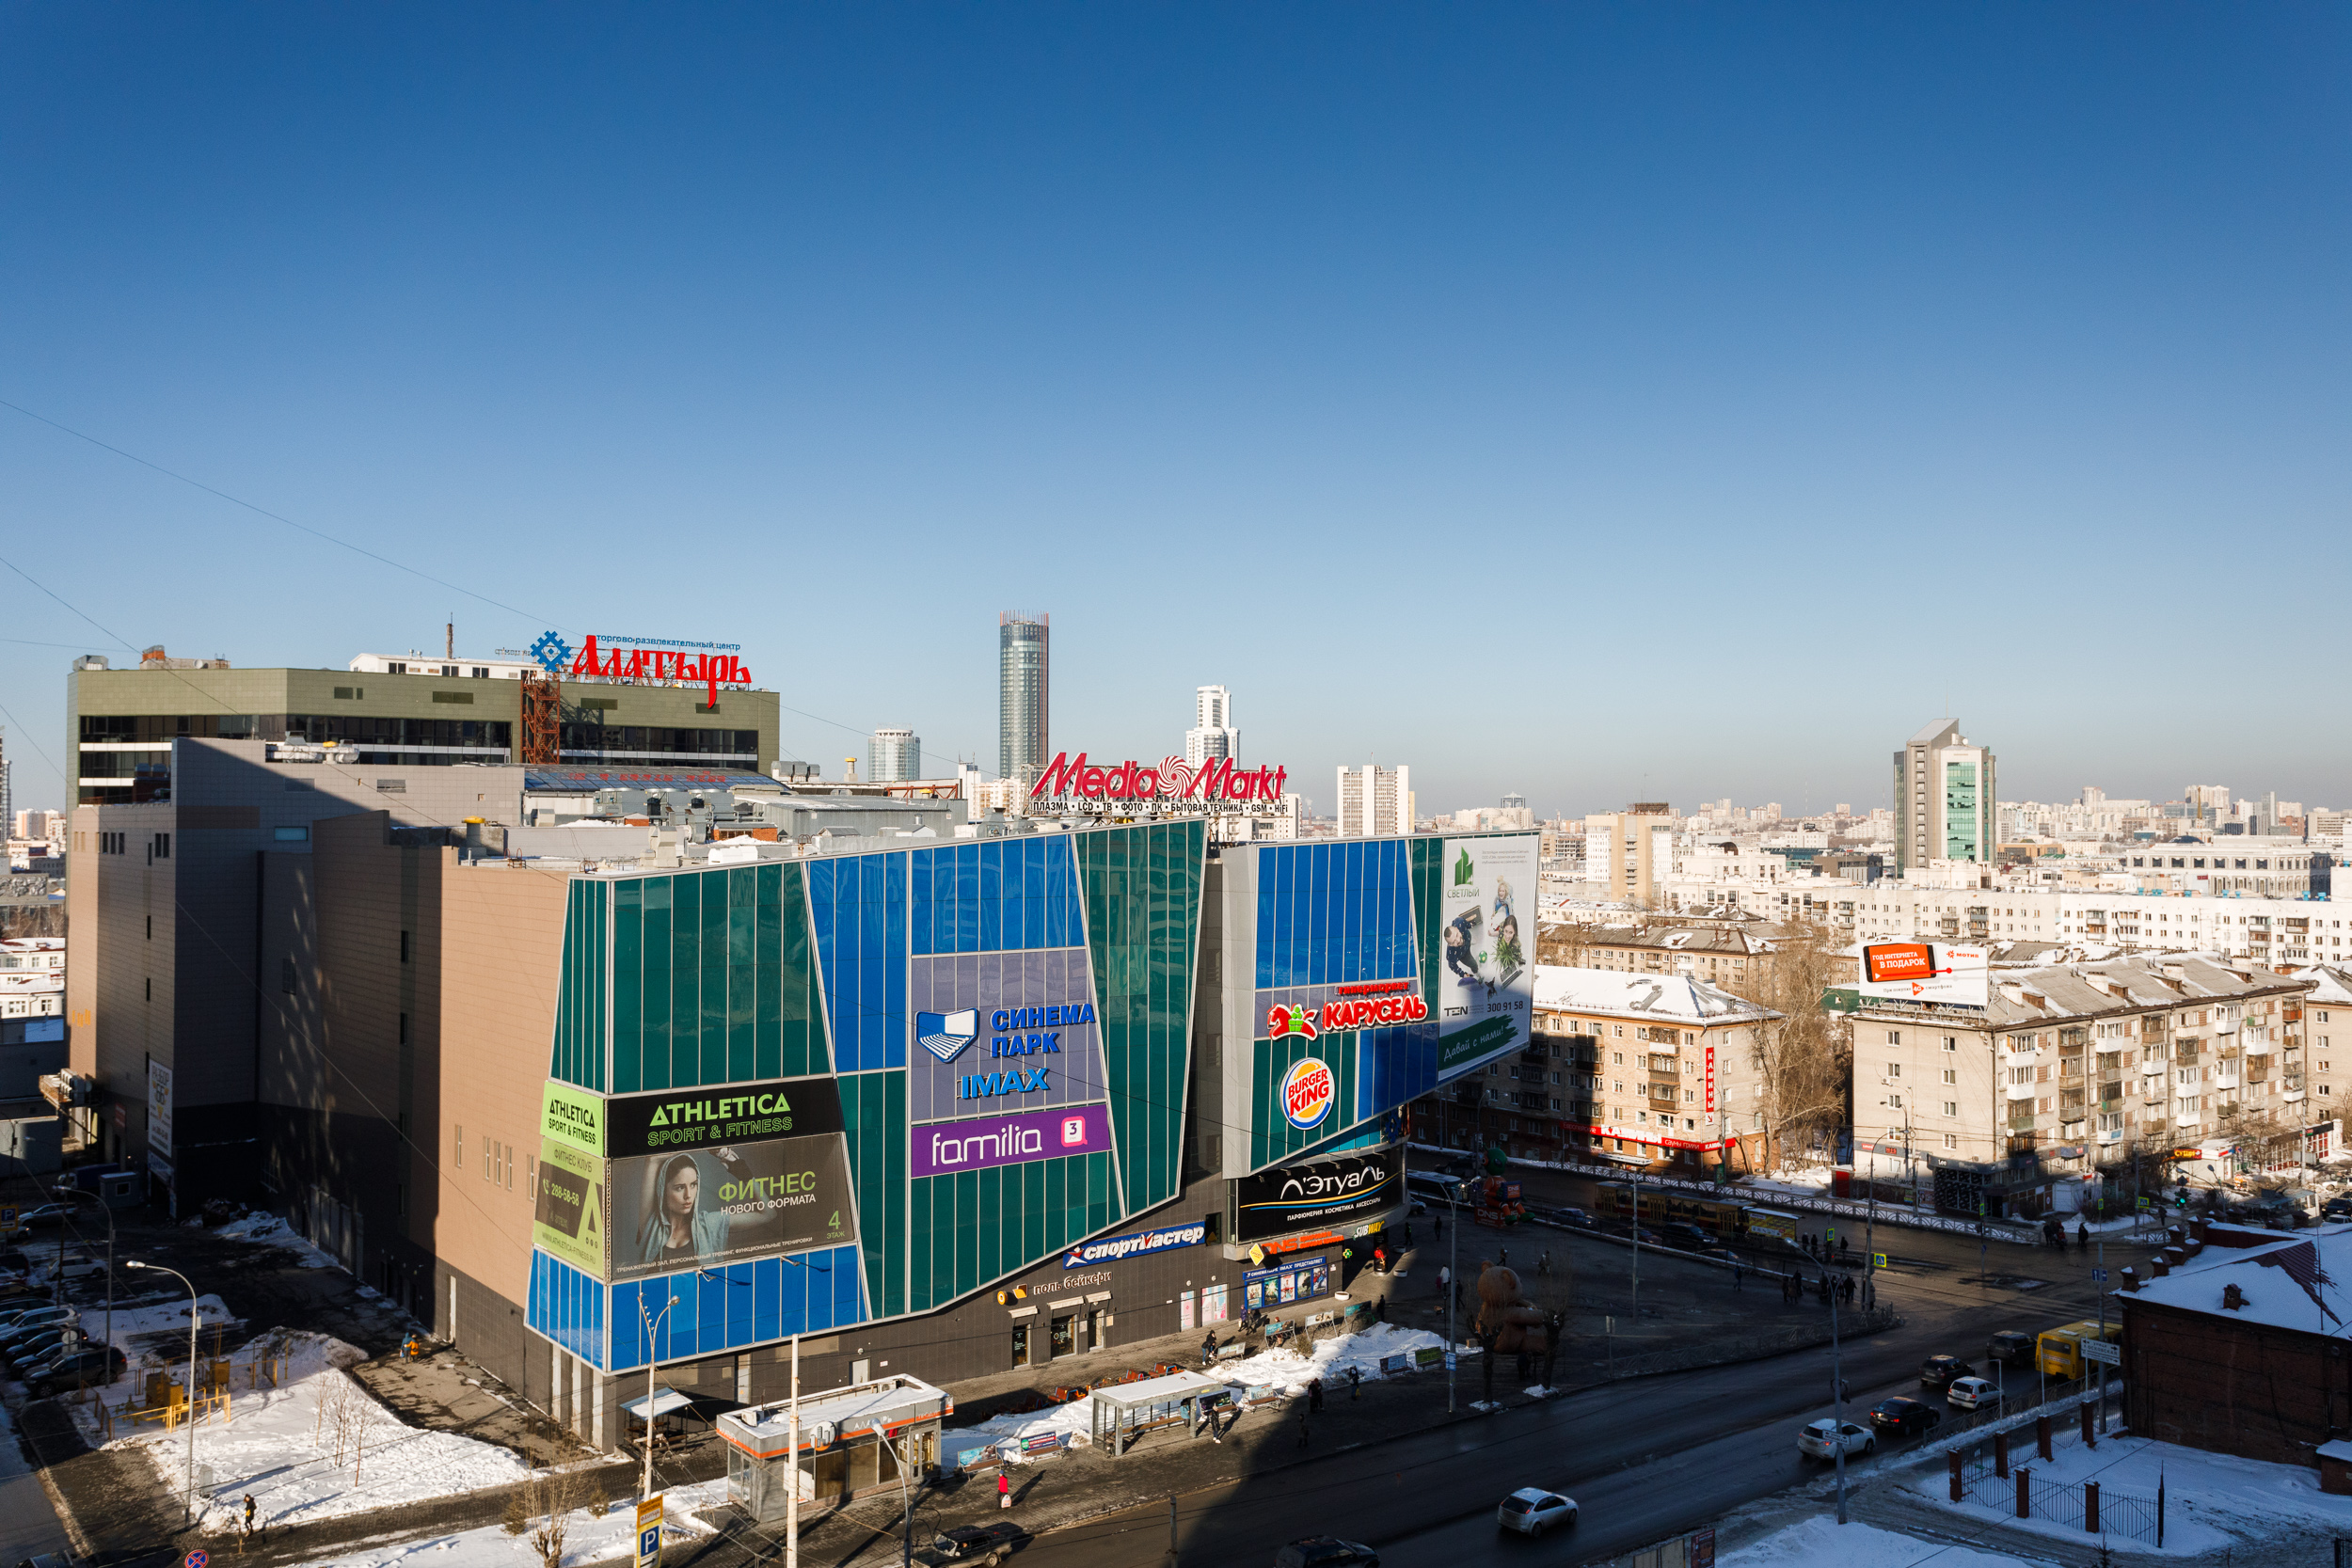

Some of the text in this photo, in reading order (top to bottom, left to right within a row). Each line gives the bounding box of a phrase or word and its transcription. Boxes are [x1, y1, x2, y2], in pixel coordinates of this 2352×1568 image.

[596, 634, 741, 651] торгово-развлекательный центр
[1033, 801, 1069, 811] ПЛАЗМА
[1077, 801, 1094, 811] LCD
[1102, 802, 1113, 811] ТВ
[1120, 802, 1143, 812] ФОТО
[1151, 802, 1163, 812] ПК
[1170, 802, 1208, 812] БЫТОВАЯ
[1209, 802, 1243, 813] ТЕХНИКА
[1251, 803, 1267, 813] GSM
[1446, 886, 1480, 898] СВЕТЛЫЙ
[1880, 958, 1926, 969] В ПОДАРОК
[1884, 951, 1918, 959] ИНТЕРНЕТА
[990, 1003, 1096, 1032] СИНЕМА
[1322, 993, 1429, 1031] КАРУСЕЛЬ
[1486, 1003, 1502, 1013] 300
[1502, 1002, 1512, 1011] 91
[1514, 1000, 1524, 1010] 58
[990, 1032, 1061, 1058] ПАРК
[1443, 1025, 1504, 1062] Давай с нами!
[960, 1067, 1050, 1100] IMAX
[1288, 1069, 1328, 1100] BURGER
[649, 1092, 791, 1127] ATHLETICA
[1289, 1081, 1329, 1118] KING
[548, 1098, 596, 1129] ATHLETICA
[548, 1117, 596, 1145] SPORT & FITNESS
[647, 1116, 793, 1147] SPORT & FITNESS
[1069, 1122, 1077, 1135] 3
[931, 1123, 1043, 1166] familia
[1664, 1139, 1682, 1148] сауны
[554, 1148, 593, 1173] ФИТНЕС КЛУБ
[551, 1182, 580, 1207] 288-58-58
[718, 1170, 817, 1203] ФИТНЕС
[721, 1194, 817, 1216] НОВОГО ФОРМАТА
[1287, 1209, 1324, 1222] ПАРФЮМЕРИЯ
[1325, 1203, 1355, 1215] КОСМЕТИКА
[828, 1210, 841, 1230] 4
[1354, 1220, 1385, 1239] SUBWAY
[826, 1230, 846, 1239] ЭТАЖ
[1262, 1238, 1298, 1255] DNS
[1033, 1271, 1113, 1296] поль бейкери
[644, 1529, 657, 1554] P
